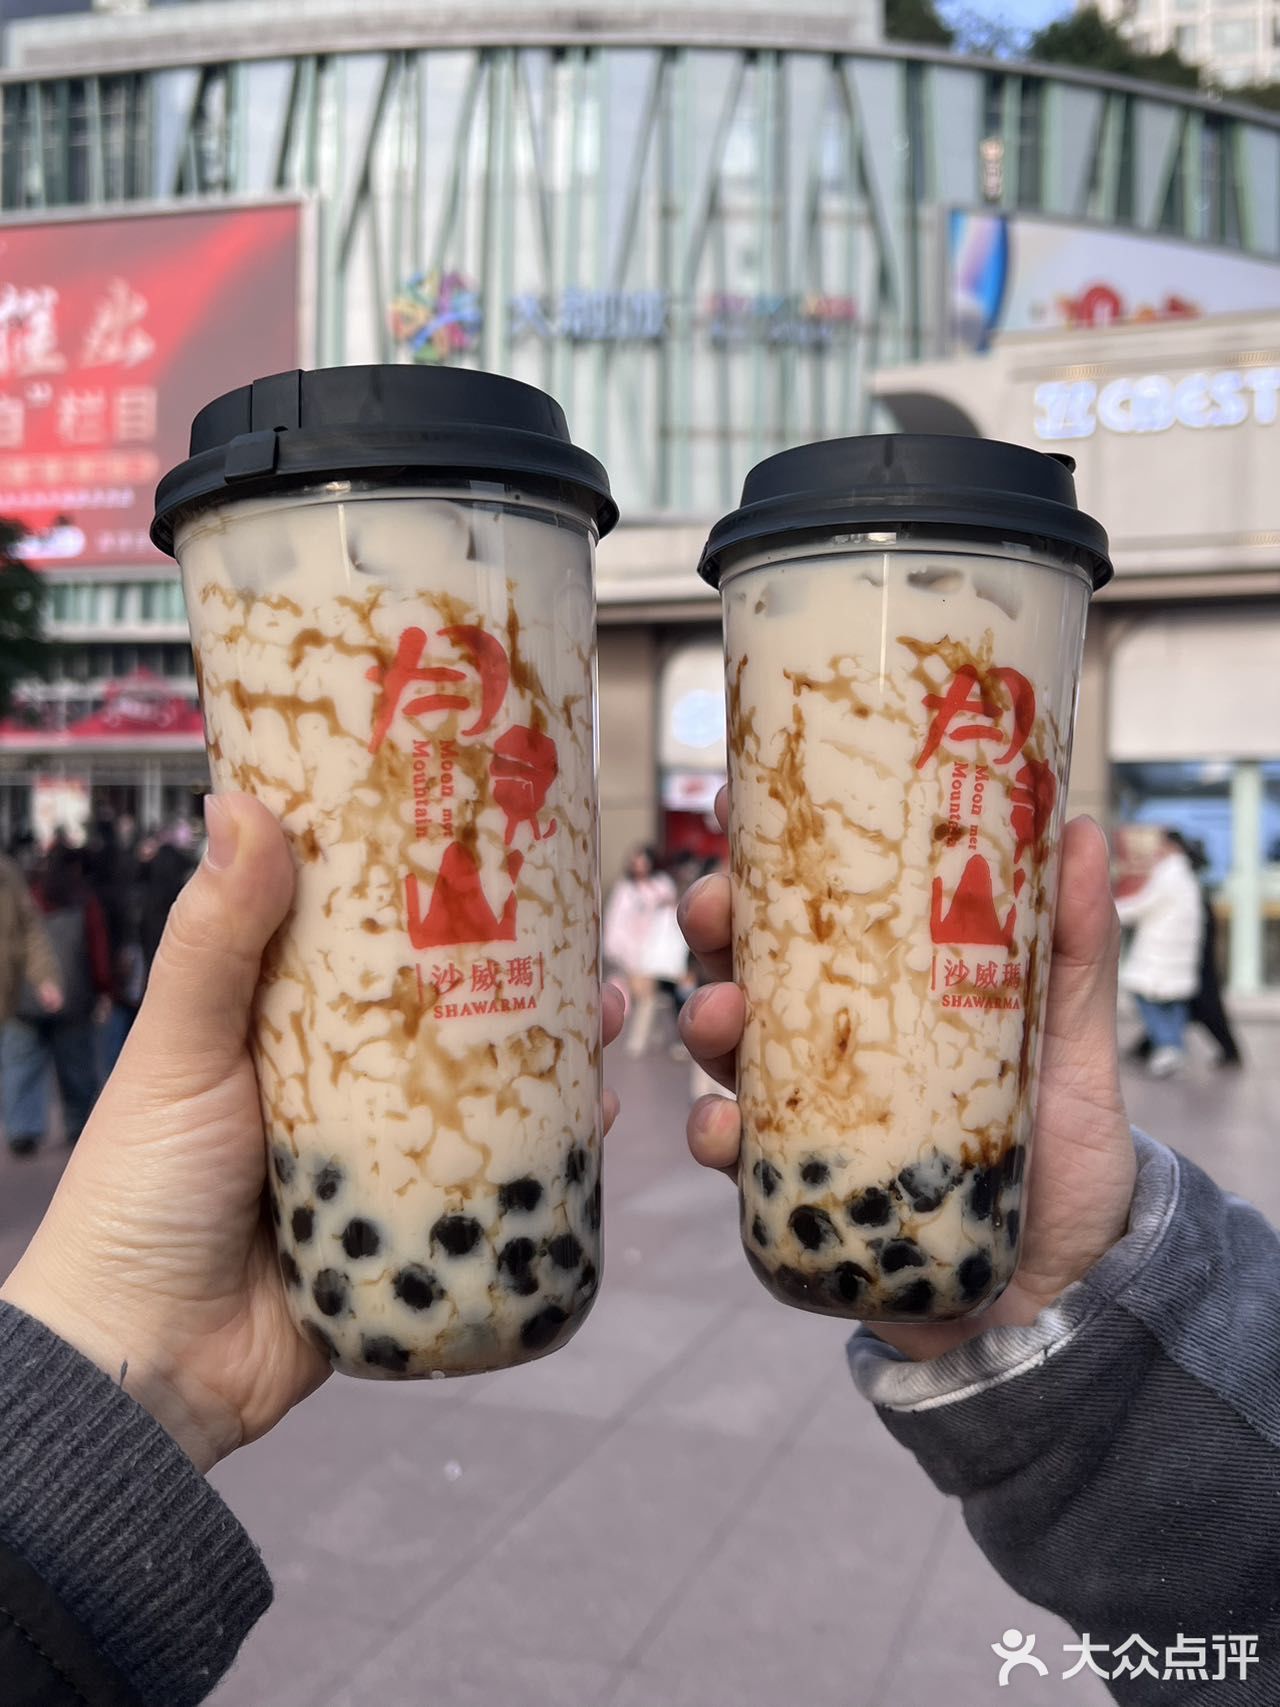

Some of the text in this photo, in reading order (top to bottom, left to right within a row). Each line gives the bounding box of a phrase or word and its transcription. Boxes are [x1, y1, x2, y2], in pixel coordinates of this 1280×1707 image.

[412, 739, 432, 839] Mountain
[971, 765, 989, 815] Moon
[432, 955, 533, 996] 沙威瑪
[944, 959, 1021, 991] 沙威瑪
[434, 995, 537, 1019] SHAWARMA
[942, 994, 1020, 1010] SHAWARMA
